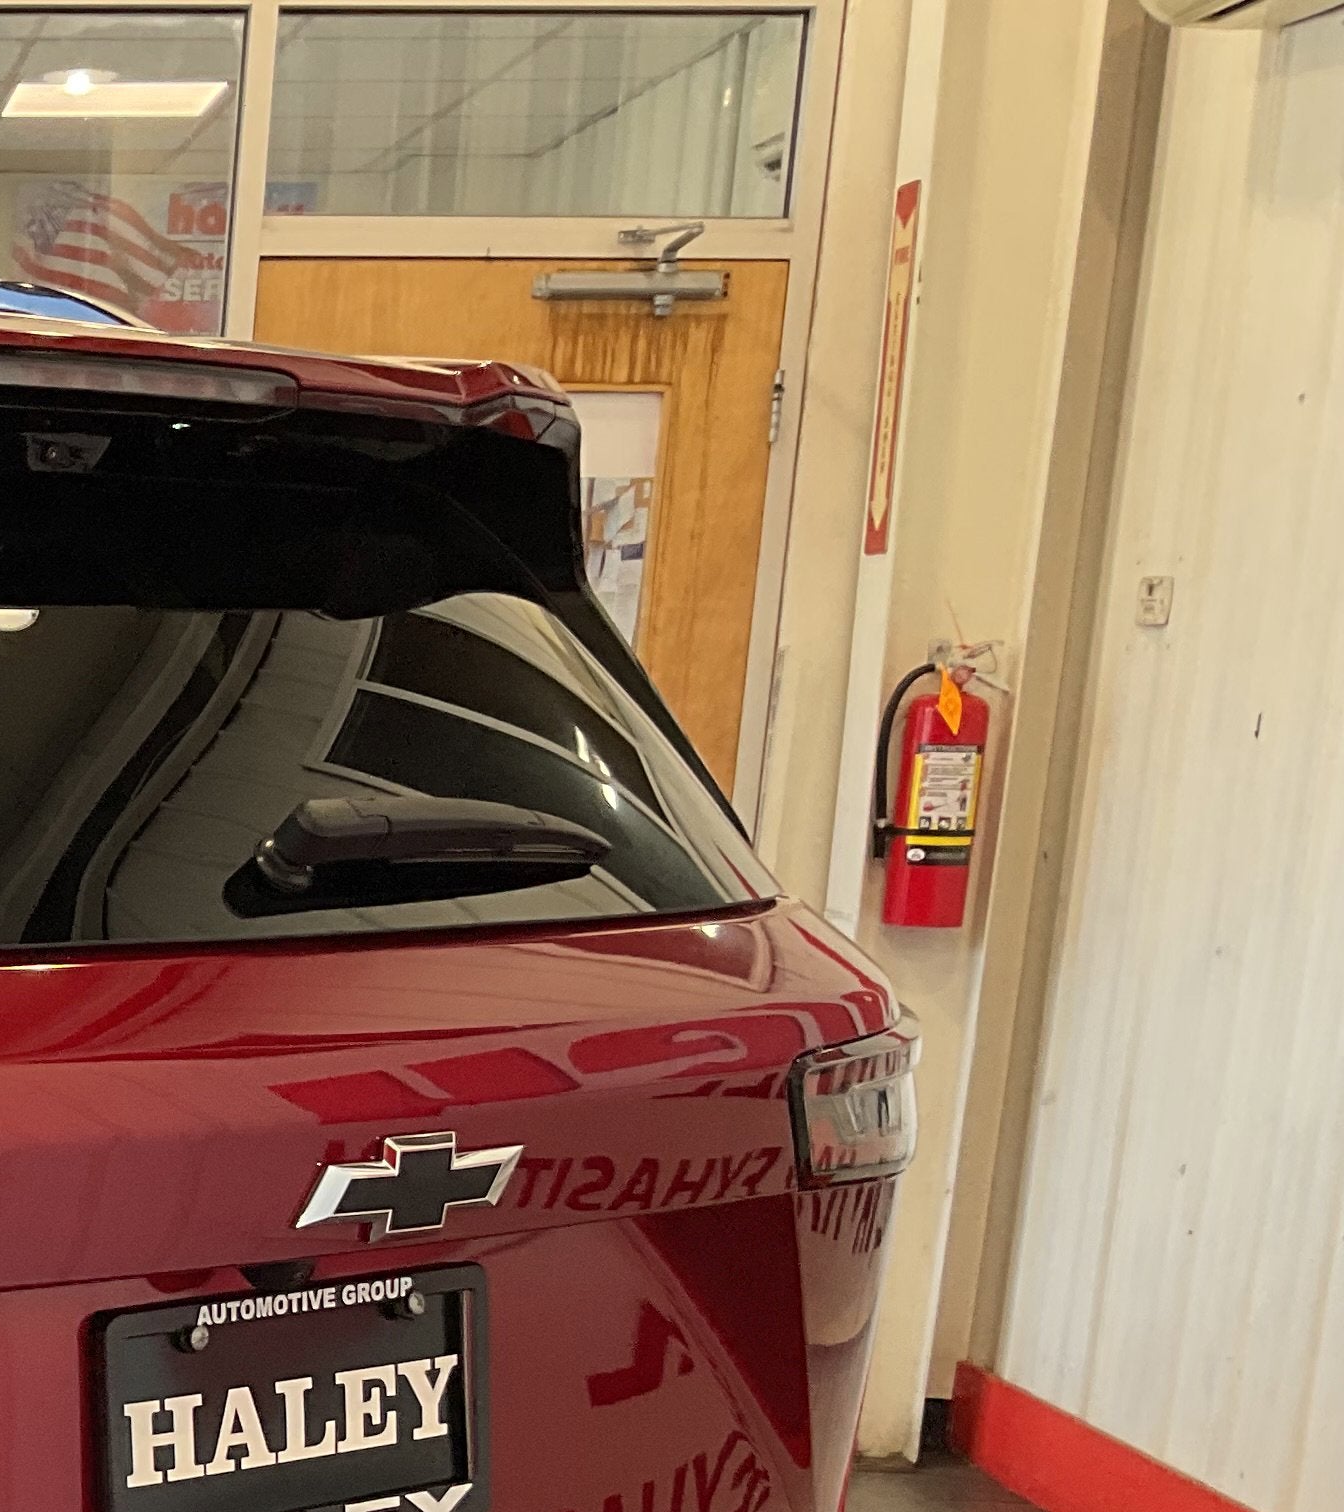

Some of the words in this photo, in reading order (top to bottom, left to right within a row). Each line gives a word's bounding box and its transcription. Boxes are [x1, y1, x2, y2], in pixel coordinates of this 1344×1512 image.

[196, 1287, 336, 1327] AUTOMOTIVE
[341, 1276, 413, 1306] GROUP
[123, 1353, 459, 1489] HALEY
